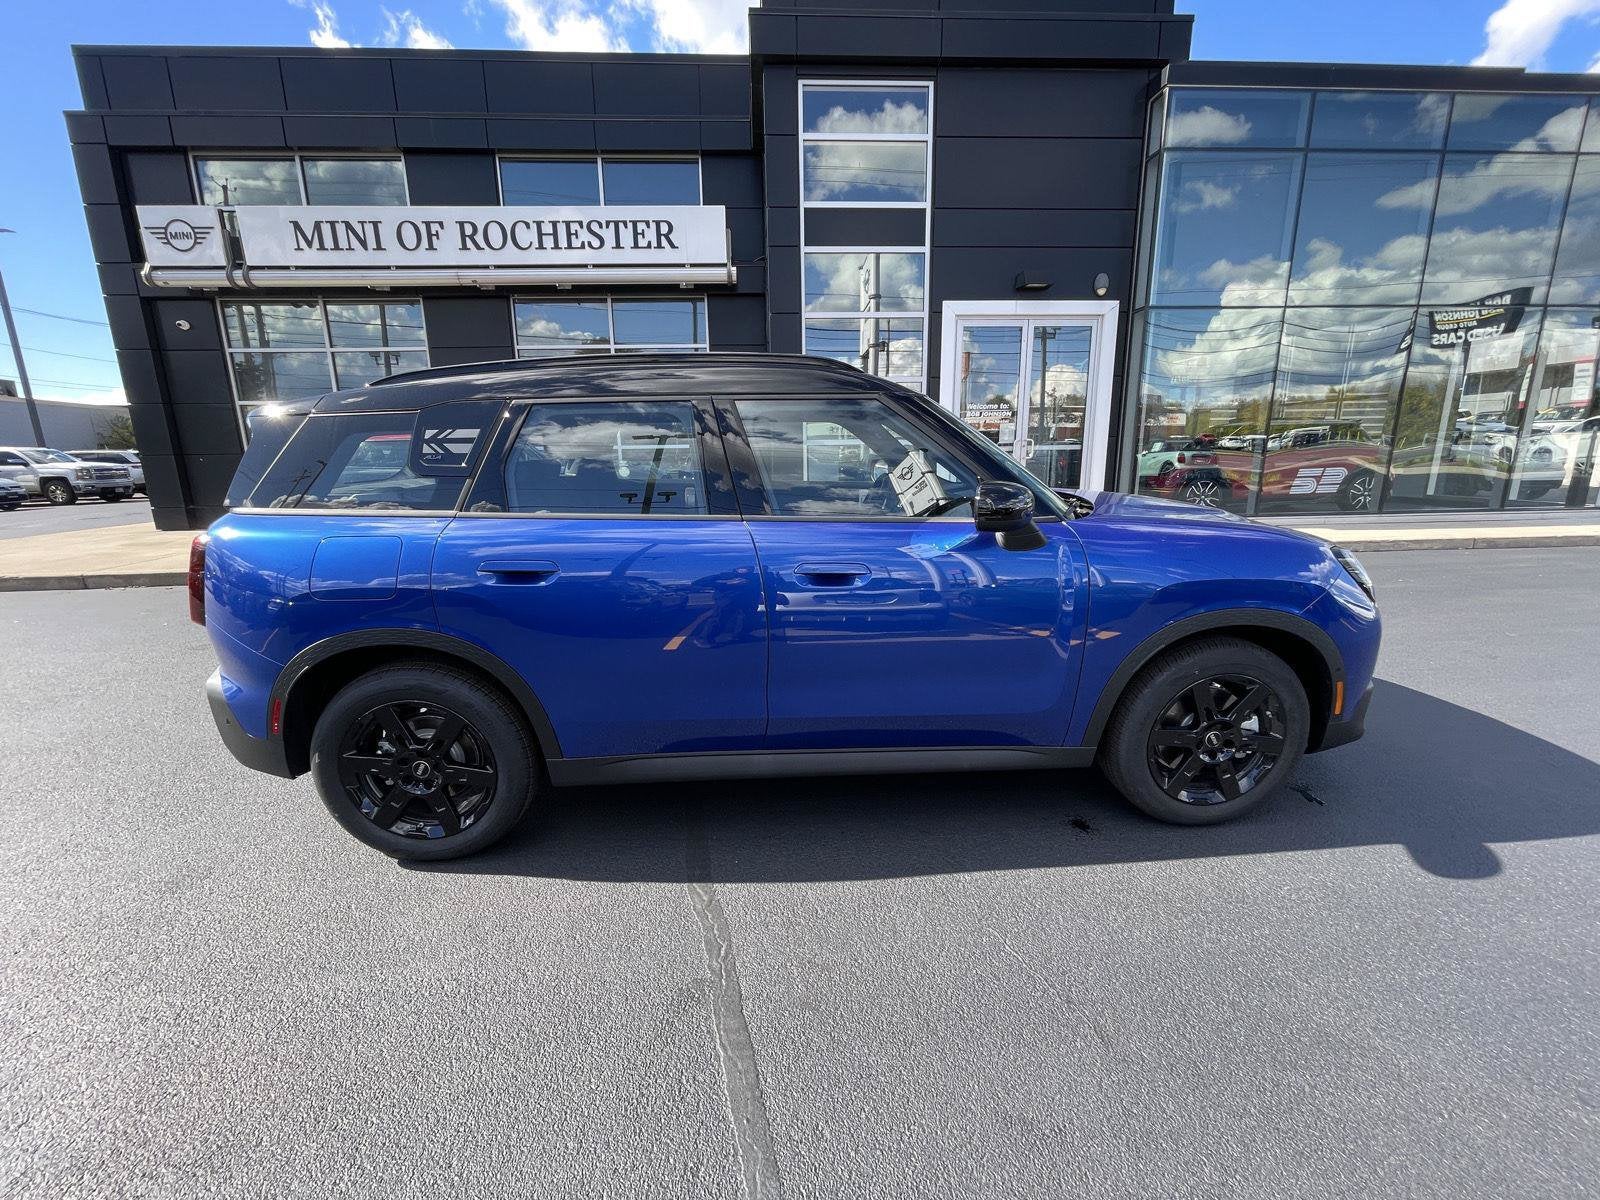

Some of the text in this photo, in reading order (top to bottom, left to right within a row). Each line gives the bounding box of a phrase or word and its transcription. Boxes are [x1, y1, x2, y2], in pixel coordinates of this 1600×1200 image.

[168, 230, 193, 241] MINI
[289, 219, 679, 252] MINI OF ROCHESTER
[1289, 467, 1348, 495] 52
